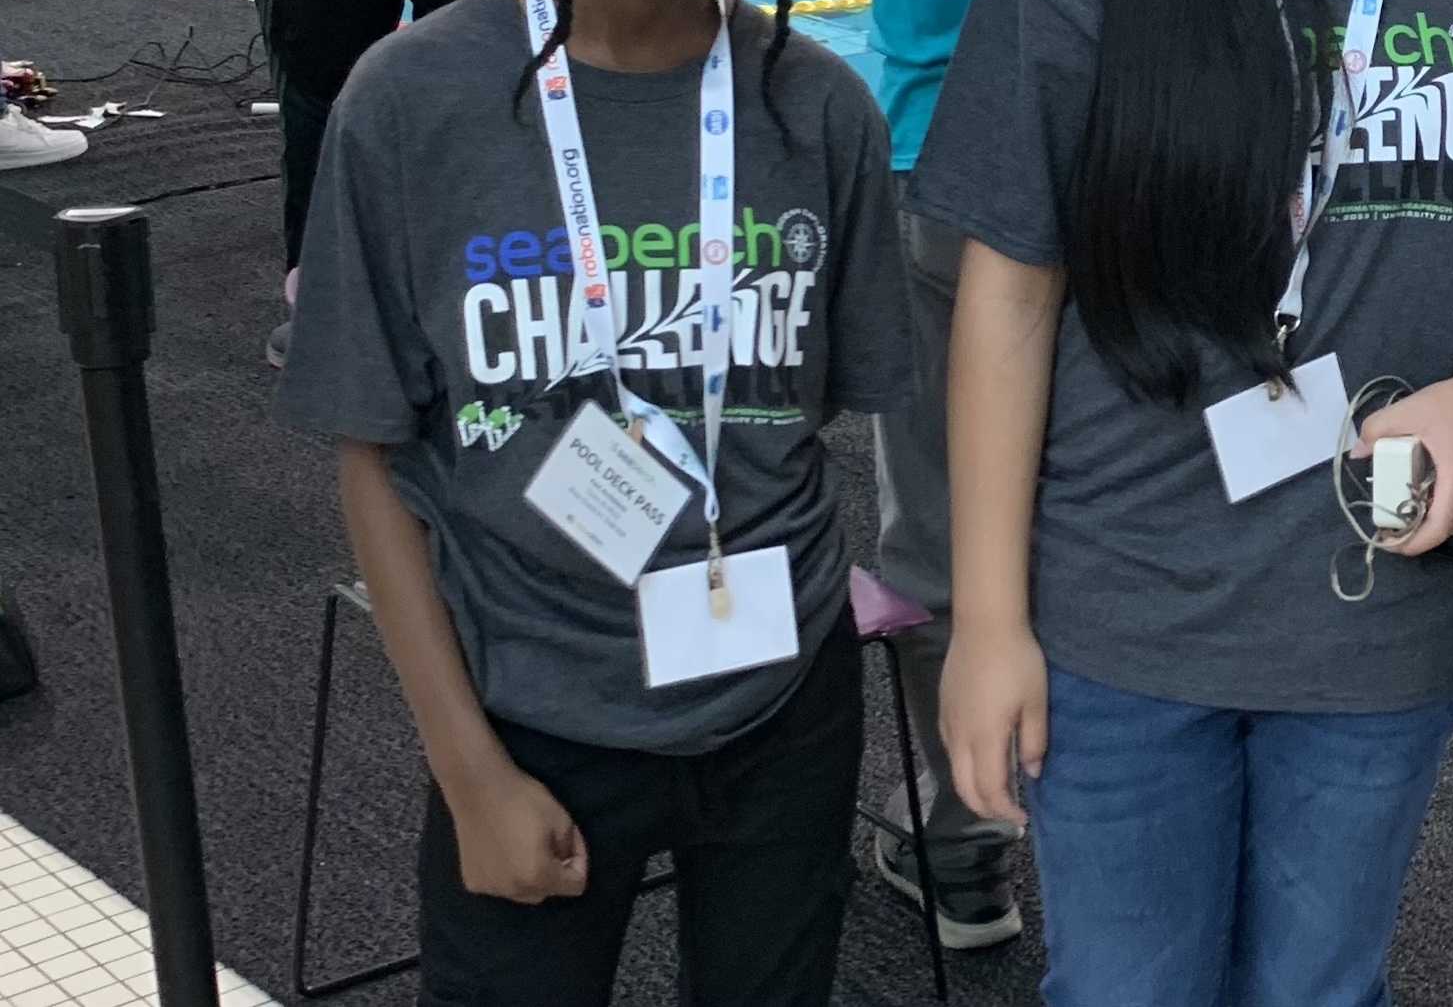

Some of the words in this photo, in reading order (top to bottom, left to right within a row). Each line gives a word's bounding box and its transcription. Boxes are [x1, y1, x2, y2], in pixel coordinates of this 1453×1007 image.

[562, 148, 598, 278] robonation.org
[569, 438, 602, 473] POOL
[602, 465, 637, 498] DECK
[633, 495, 666, 527] PASS
